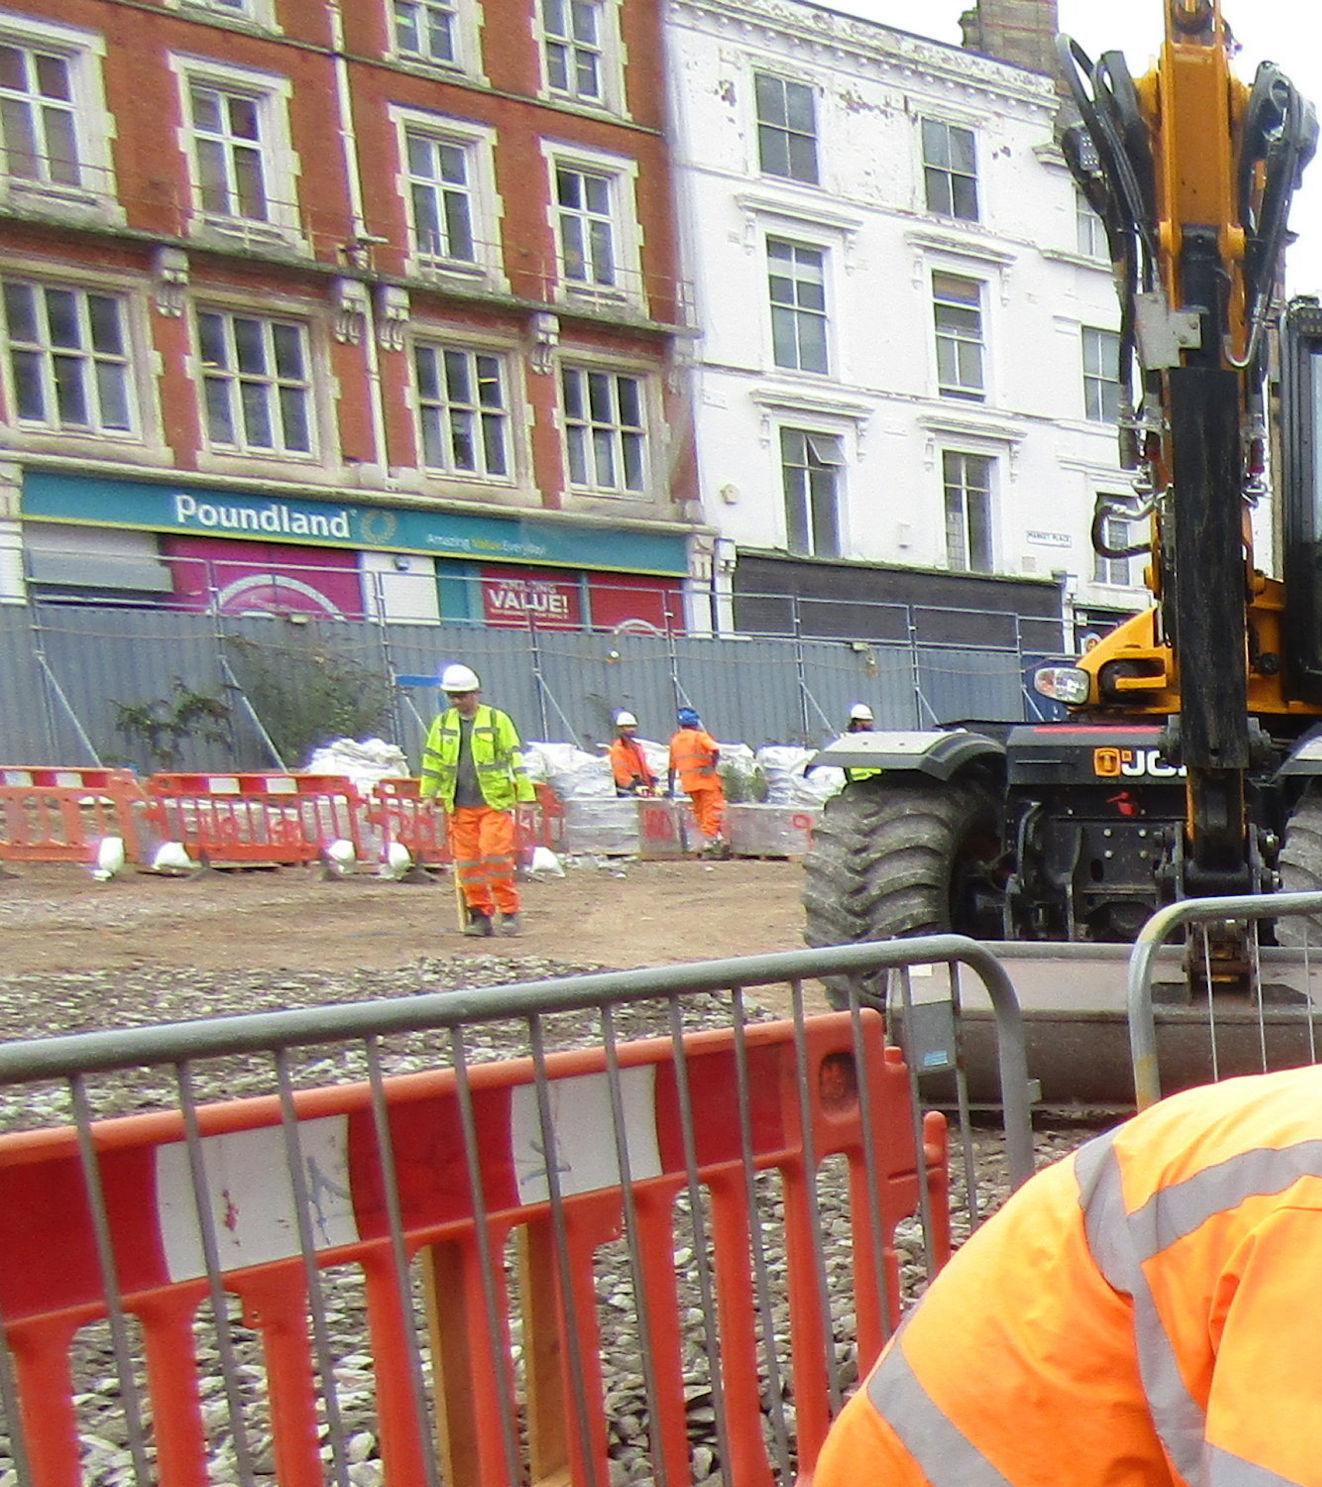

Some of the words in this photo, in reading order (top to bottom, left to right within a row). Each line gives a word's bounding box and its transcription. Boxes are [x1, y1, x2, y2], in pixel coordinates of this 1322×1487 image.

[174, 494, 351, 539] Poundland
[488, 588, 569, 614] VALUE!
[1121, 749, 1188, 777] JC
